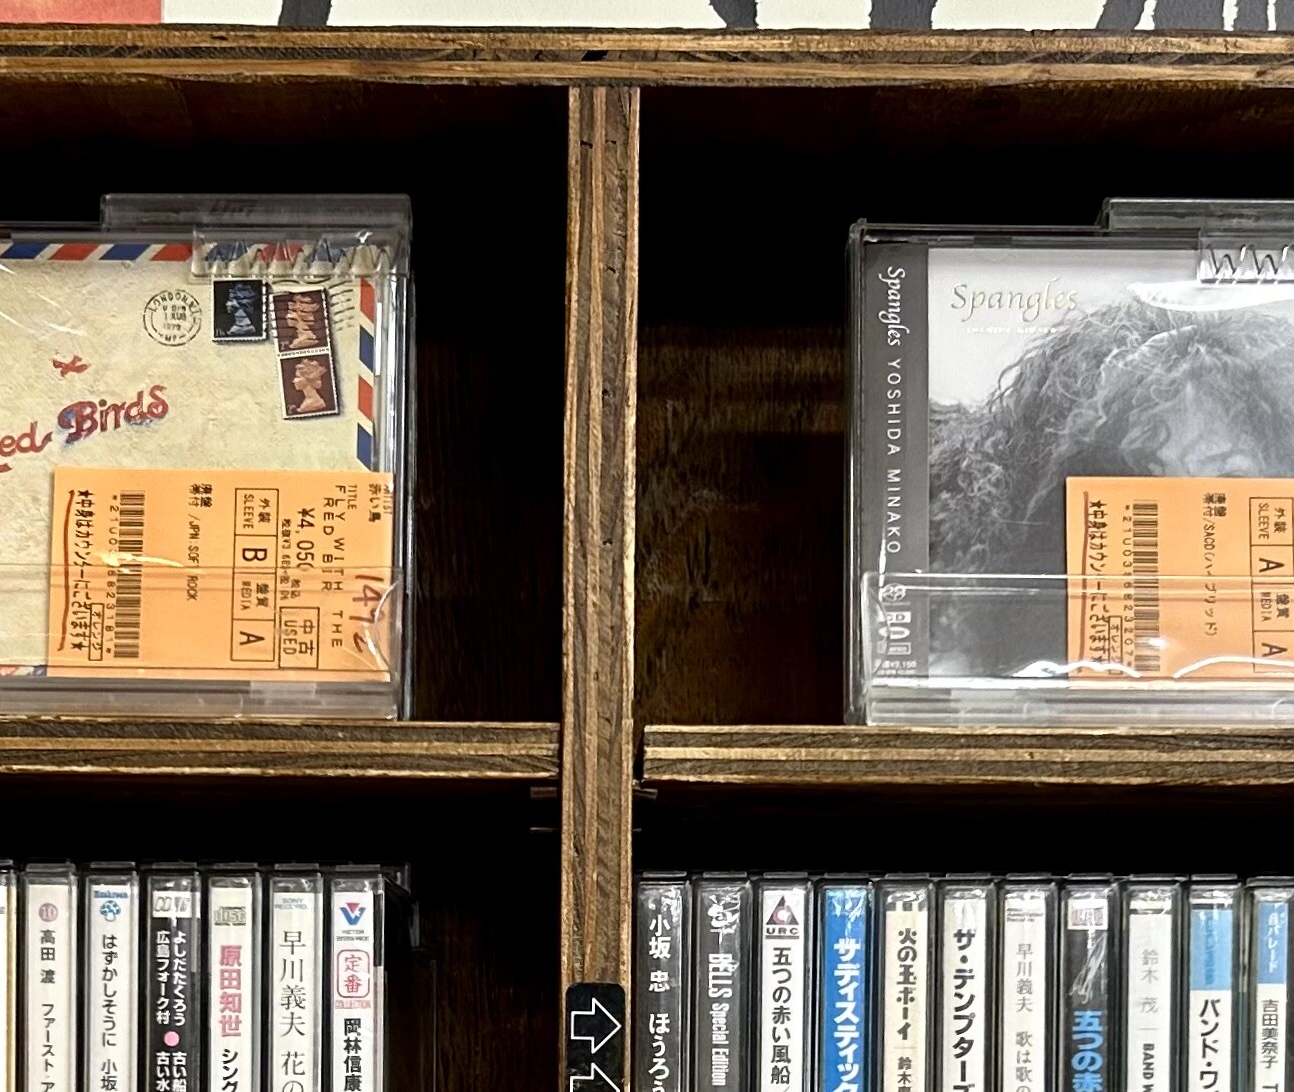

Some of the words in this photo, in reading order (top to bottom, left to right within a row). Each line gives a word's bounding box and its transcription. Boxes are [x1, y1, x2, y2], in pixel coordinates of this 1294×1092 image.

[877, 266, 910, 346] Spangles
[950, 276, 1079, 322] Spangles
[58, 384, 170, 445] Birds
[887, 359, 901, 456] YOSHIDA
[243, 493, 254, 529] SLEEVE
[323, 497, 335, 536] RED
[335, 485, 346, 522] FLY
[887, 469, 901, 554] MINAKO
[1257, 503, 1269, 540] SLEEVE
[322, 554, 333, 592] BIR
[334, 537, 345, 592] WITH
[283, 620, 297, 655] USED
[297, 620, 314, 656] 中古
[331, 610, 343, 648] THE
[102, 934, 117, 1047] はずかしそうに
[156, 930, 170, 1026] 広島フォーク村
[172, 930, 187, 1027] よしだたくろう
[218, 945, 242, 1039] 原田知世
[279, 929, 307, 1038] 早川義夫
[895, 928, 917, 1042] 火の玉ボーイ
[343, 1018, 362, 1092] 岡林信康
[1261, 1000, 1278, 1069] 吉田美奈子
